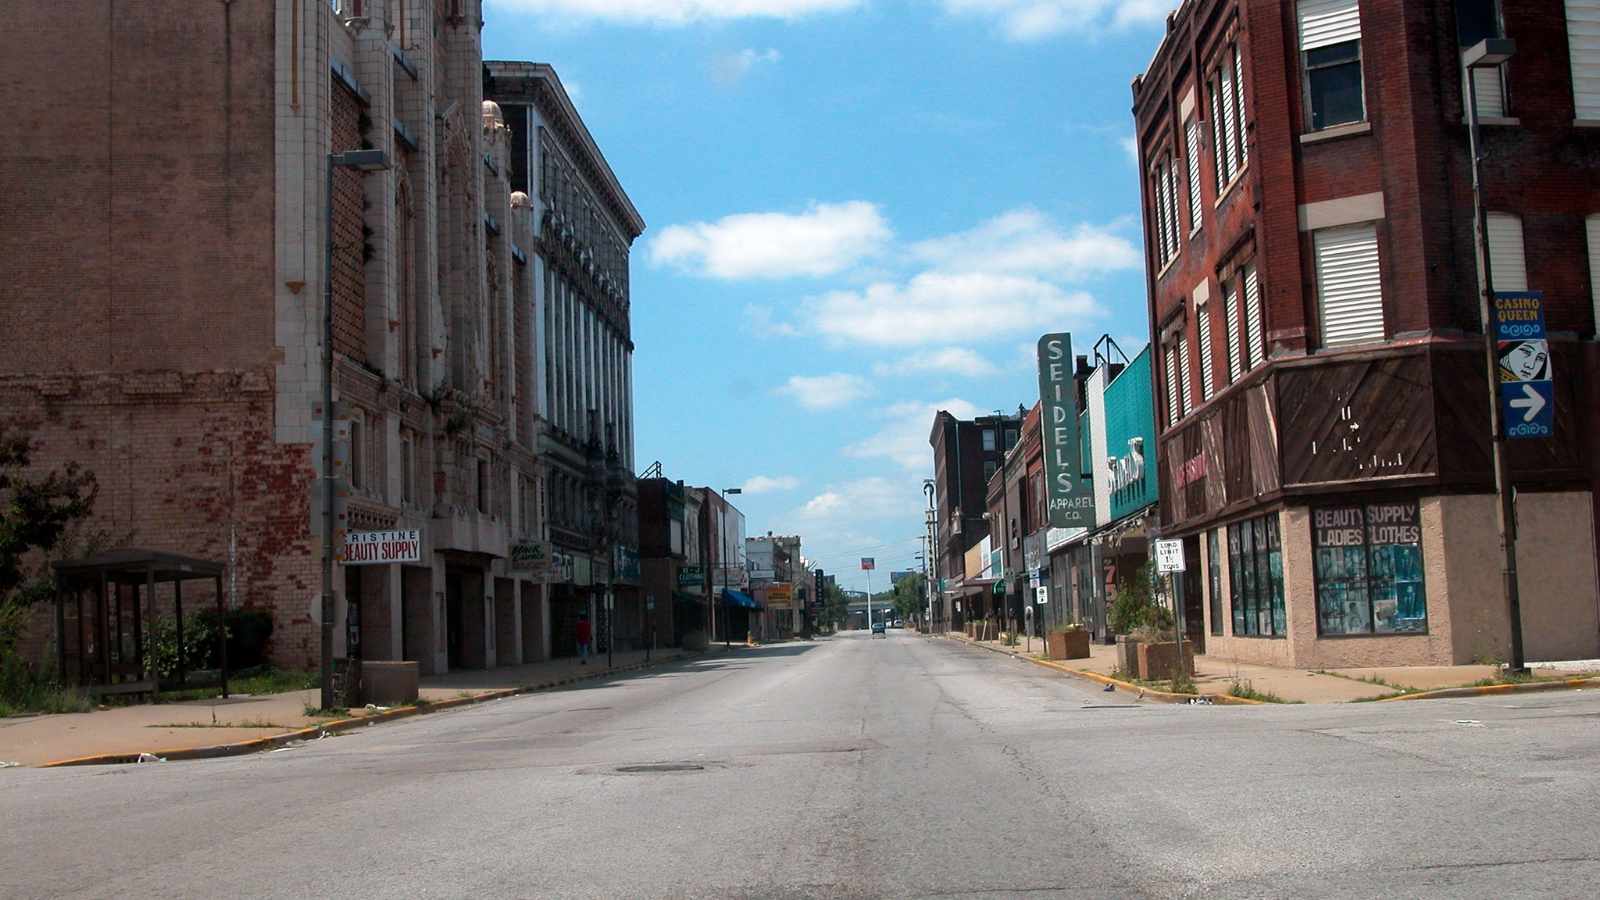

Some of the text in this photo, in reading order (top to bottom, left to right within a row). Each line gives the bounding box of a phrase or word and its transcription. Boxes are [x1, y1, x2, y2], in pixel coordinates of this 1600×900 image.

[1496, 298, 1540, 309] CASINO
[1498, 310, 1538, 322] QUEEN
[1047, 340, 1073, 492] SEIDELS
[1050, 496, 1095, 510] APPAREL
[1315, 505, 1415, 529] BEAUTY SUPPLY
[344, 531, 417, 543] RISTINE
[1318, 529, 1364, 546] LADIES
[381, 541, 418, 560] SUPPLY
